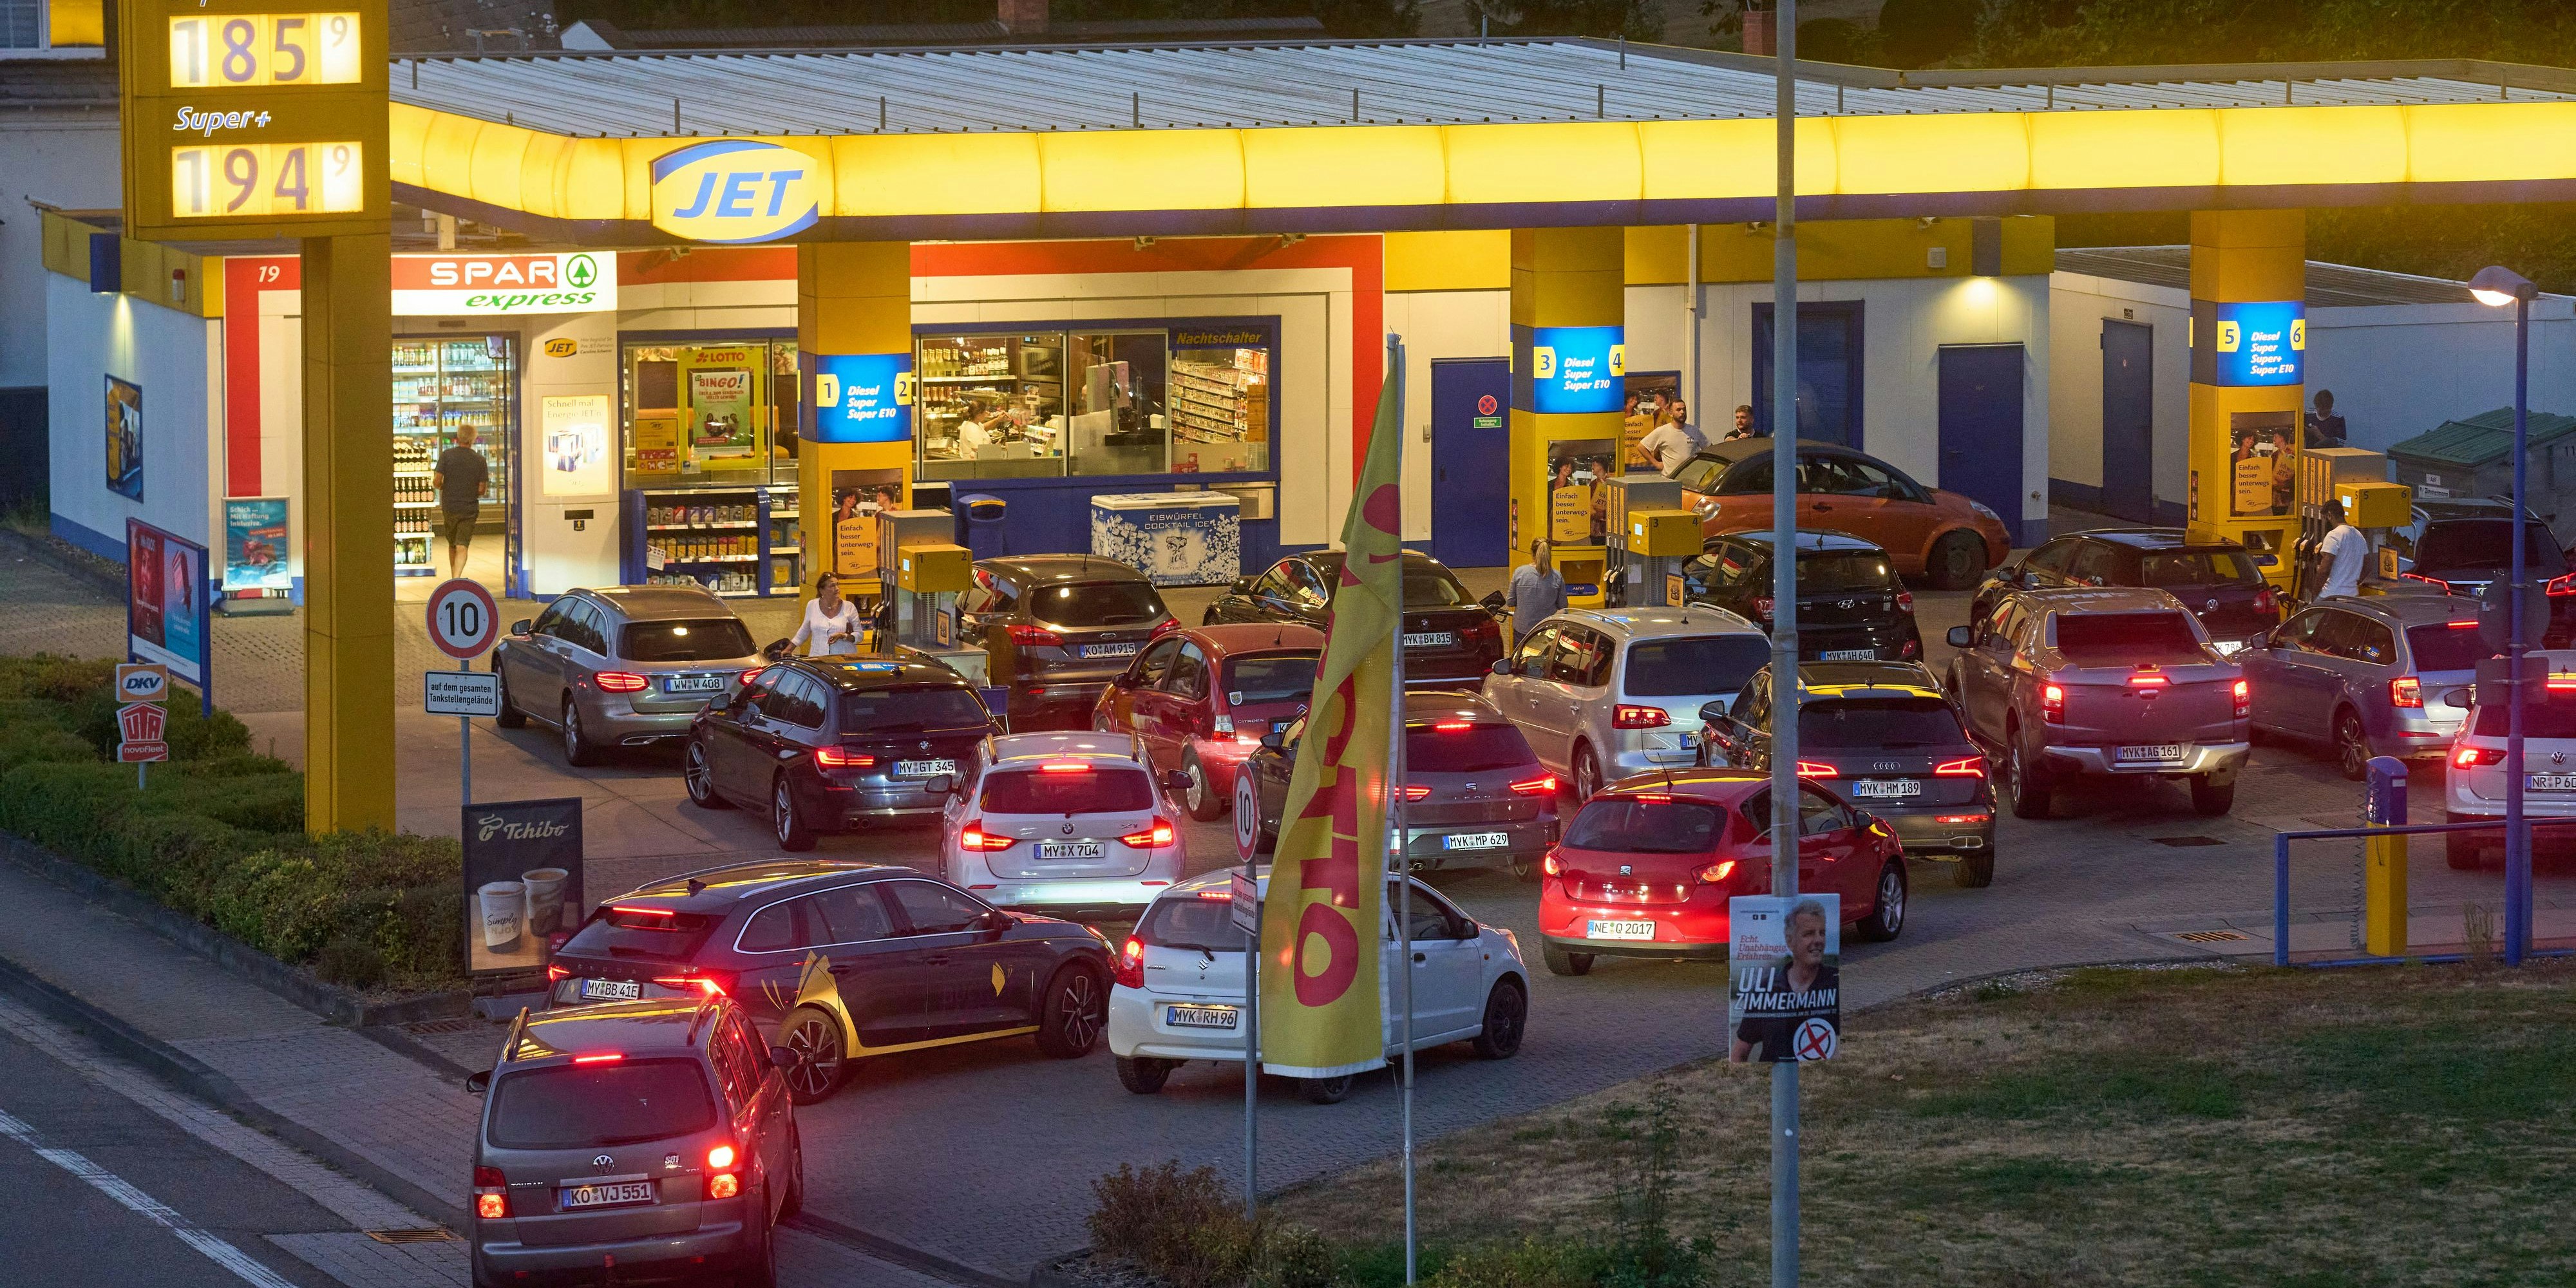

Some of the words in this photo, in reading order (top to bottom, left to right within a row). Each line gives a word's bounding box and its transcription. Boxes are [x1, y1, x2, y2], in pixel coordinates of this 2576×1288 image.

[173, 106, 272, 137] Super+
[673, 169, 804, 218] JET
[258, 265, 280, 283] 19
[430, 260, 556, 285] SPAR
[466, 290, 596, 310] express
[1177, 332, 1262, 344] Nachtschalter
[2225, 329, 2235, 344] 5
[2251, 332, 2281, 341] Diesel
[2293, 327, 2301, 343] 6
[549, 343, 574, 353] JET
[2251, 344, 2278, 354] Super
[710, 352, 744, 363] LOTTO
[1540, 355, 1550, 370] 3
[1564, 357, 1595, 368] Diesel
[1613, 353, 1622, 368] 4
[2250, 355, 2282, 365] Super+
[1564, 369, 1592, 379] Super
[2250, 366, 2278, 377] Super
[2278, 365, 2294, 374] E10
[699, 374, 744, 388] BINGO!
[1564, 380, 1593, 392] Super
[1594, 379, 1610, 389] E10
[824, 383, 831, 398] 1
[848, 385, 880, 396] Diesel
[899, 381, 907, 397] 2
[547, 399, 576, 408] Schnell
[848, 397, 877, 408] Super
[547, 410, 578, 419] Energie
[848, 409, 877, 421] Super
[878, 408, 896, 418] E10
[1150, 513, 1204, 521] EISWÜRFEL
[1653, 519, 1659, 527] 3
[1692, 518, 1698, 527] 4
[919, 554, 924, 563] 1
[961, 552, 967, 561] 2
[446, 601, 479, 637] 10
[1422, 634, 1435, 644] BW
[1436, 633, 1451, 643] 815
[1084, 645, 1097, 655] KO
[1104, 645, 1116, 654] AM
[1117, 644, 1135, 654] 915
[1827, 651, 1841, 661] MYK
[1847, 650, 1857, 661] AH
[1859, 650, 1873, 660] 640
[126, 676, 162, 689] DKV
[431, 683, 442, 691] auf
[443, 683, 457, 692] dem
[459, 684, 491, 694] gesamten
[674, 679, 687, 690] WW
[693, 679, 702, 689] W
[702, 678, 720, 688] 408
[429, 694, 493, 706] Tankstellengelände
[124, 744, 165, 754] novofleet
[2122, 746, 2140, 757] MYK
[2147, 746, 2159, 757] AG
[2161, 746, 2179, 756] 161
[898, 762, 912, 773] MY
[919, 761, 933, 772] GT
[934, 761, 954, 772] 345
[1861, 782, 1879, 793] MYK
[1886, 782, 1899, 793] HM
[1901, 782, 1919, 793] 189
[2533, 777, 2546, 788] NR
[2555, 777, 2562, 787] P
[1238, 790, 1252, 836] 10
[503, 820, 569, 840] Tchibo
[1450, 837, 1468, 848] MYK
[1476, 836, 1488, 847] MP
[1490, 834, 1507, 845] 629
[1044, 846, 1059, 857] MY
[1067, 846, 1075, 857] X
[1077, 844, 1099, 857] 704
[487, 912, 517, 927] Simply
[1595, 922, 1609, 934] NE
[1616, 922, 1624, 934] Q
[1625, 922, 1653, 934] 2017
[1739, 944, 1788, 953] Unabhängig.
[1739, 967, 1776, 992] ULI
[587, 981, 600, 995] MY
[605, 983, 618, 996] BB
[620, 985, 638, 998] 41E
[1734, 988, 1837, 1010] ZIMMERMANN
[1174, 1009, 1197, 1023] MYK
[1203, 1011, 1218, 1025] RH
[1220, 1012, 1235, 1025] 96
[571, 1189, 591, 1206] KO
[600, 1186, 619, 1203] VJ
[621, 1182, 650, 1200] 551
